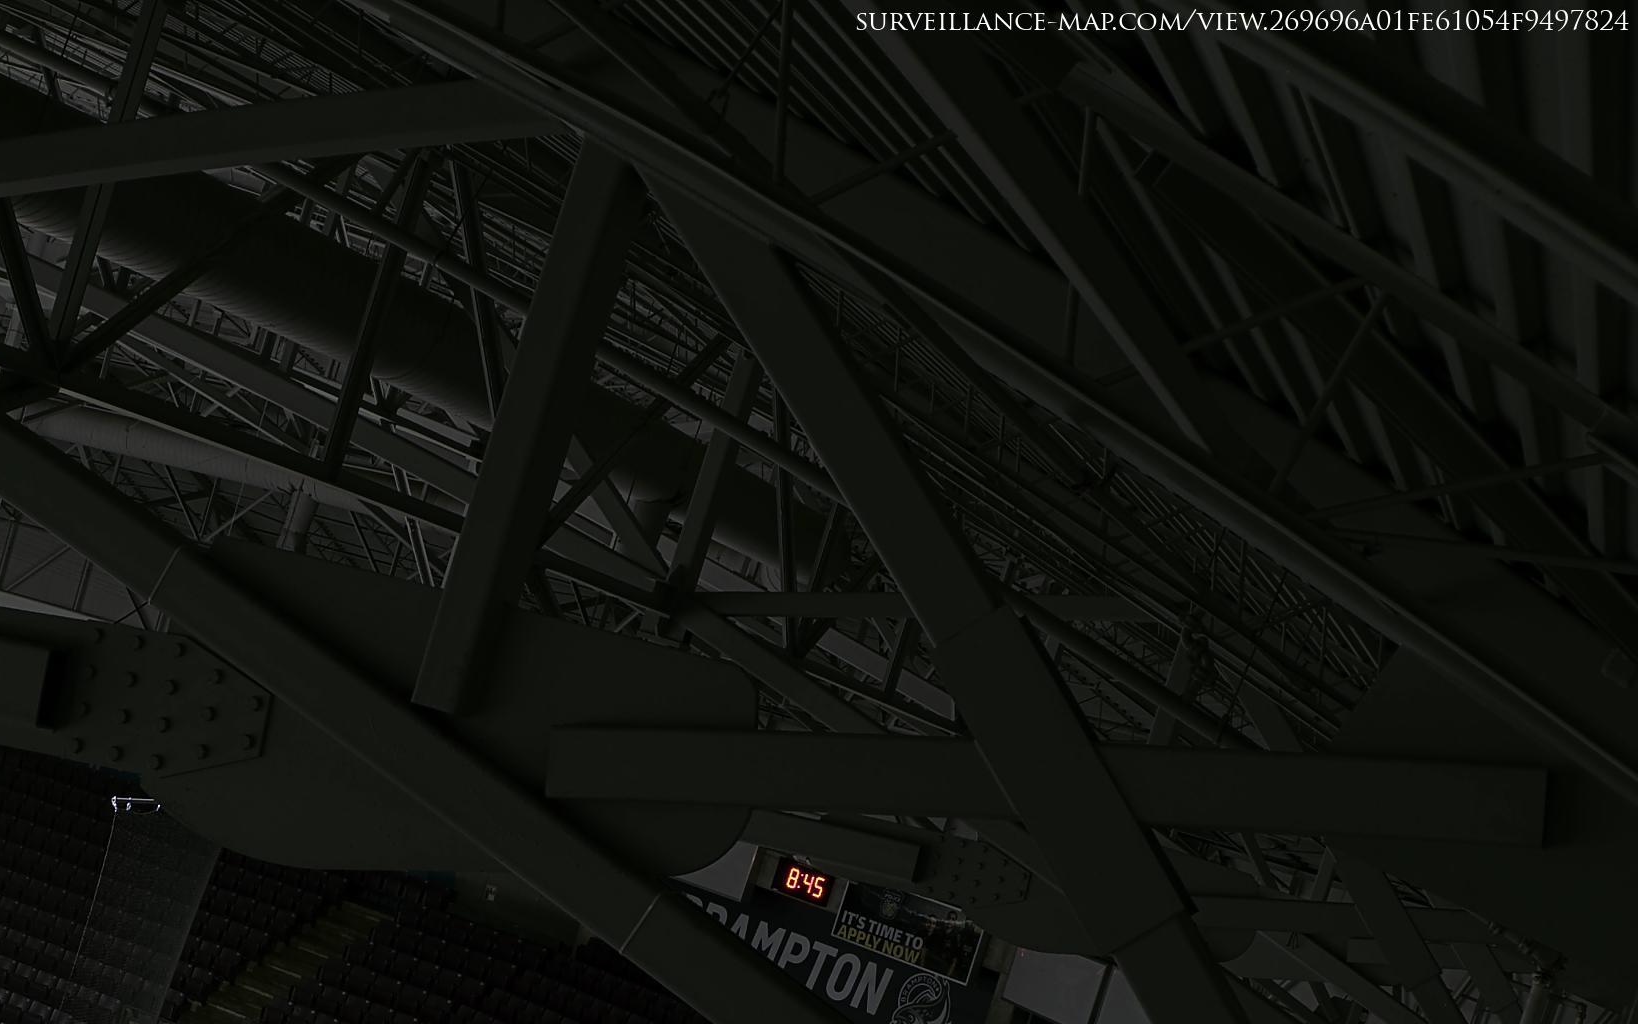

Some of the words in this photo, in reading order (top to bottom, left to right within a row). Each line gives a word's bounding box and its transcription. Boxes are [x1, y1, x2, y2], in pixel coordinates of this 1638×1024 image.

[786, 867, 827, 899] 8:45
[838, 923, 881, 950] APPLY
[841, 910, 867, 931] IT'S
[868, 918, 902, 945] TIME
[904, 931, 924, 949] TO
